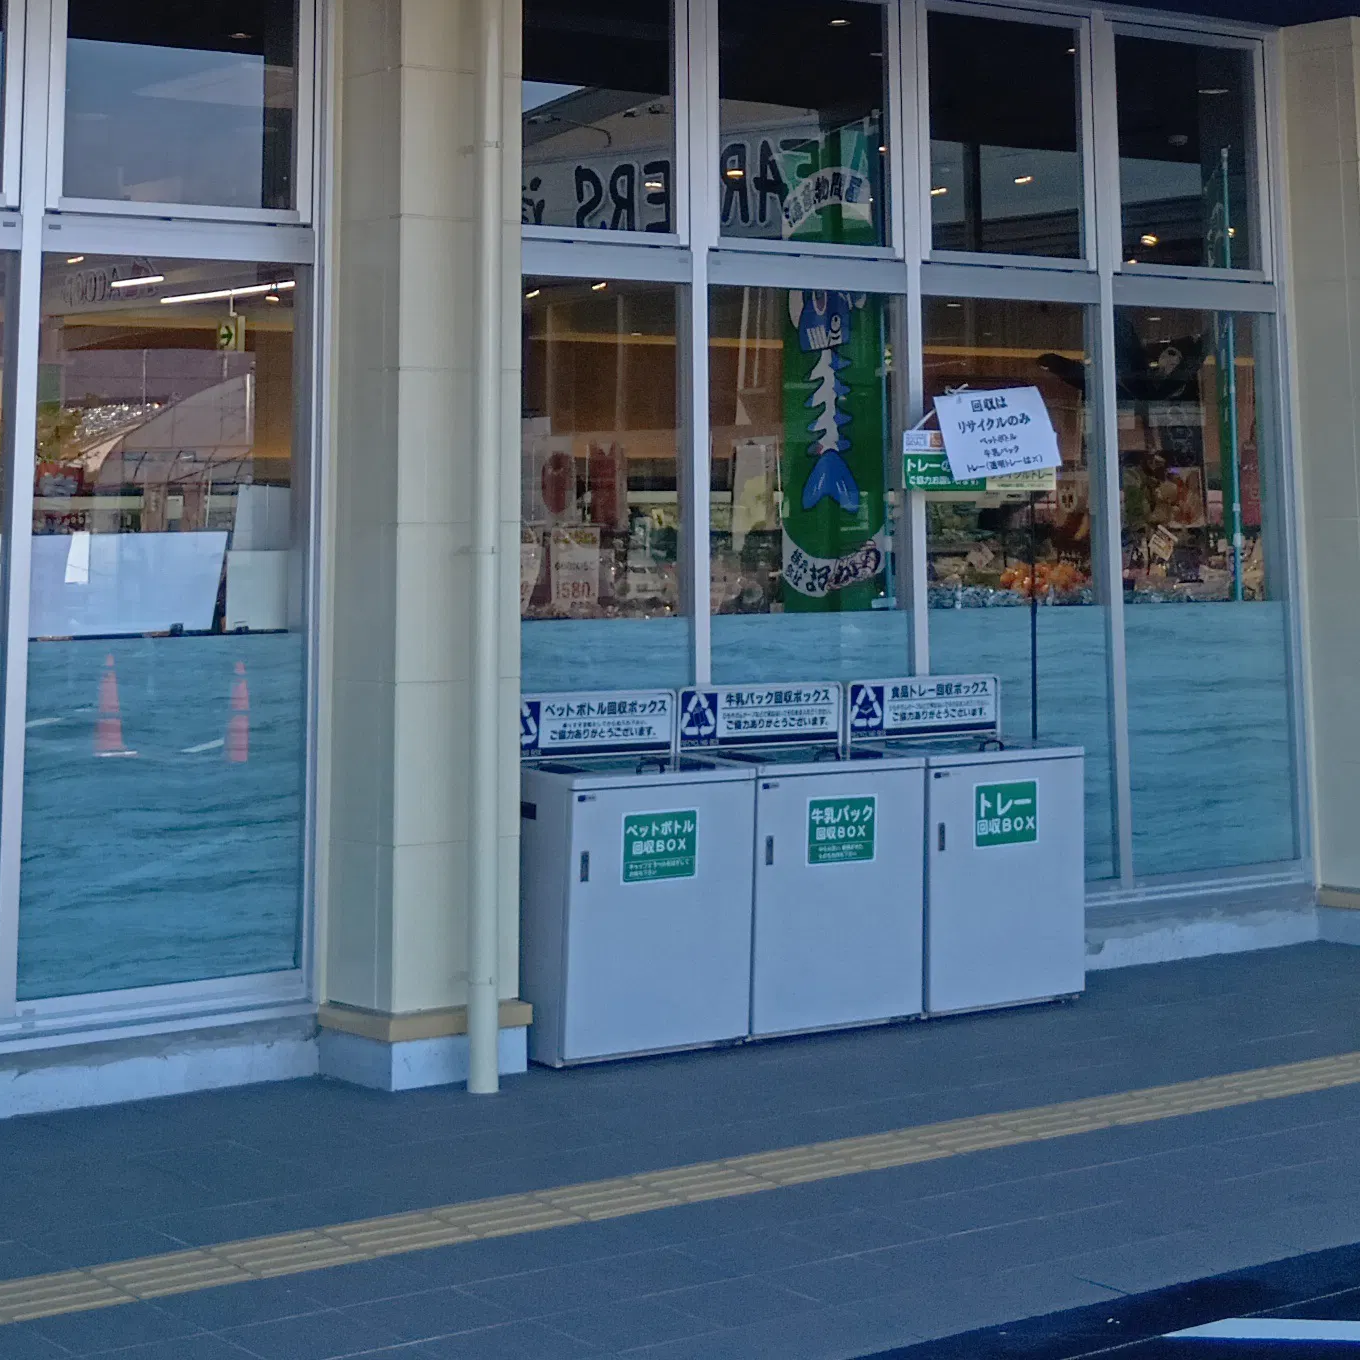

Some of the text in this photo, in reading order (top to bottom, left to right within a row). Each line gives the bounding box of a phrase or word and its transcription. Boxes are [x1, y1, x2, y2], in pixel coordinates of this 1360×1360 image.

[970, 395, 1008, 413] 回収は
[957, 412, 1031, 434] リサイクルのみ
[725, 689, 830, 706] 牛乳パック回収ボックス
[891, 681, 988, 699] 食品トレー回収ボックス
[544, 700, 668, 717] ペットボトル回収ボックス
[811, 804, 873, 825] 牛乳パック
[980, 792, 1032, 818] トレー
[626, 819, 695, 838] ペットボトル
[815, 824, 866, 841] 回収BOX
[976, 815, 1036, 836] 回収BOX
[631, 837, 687, 856] 回収BOX
